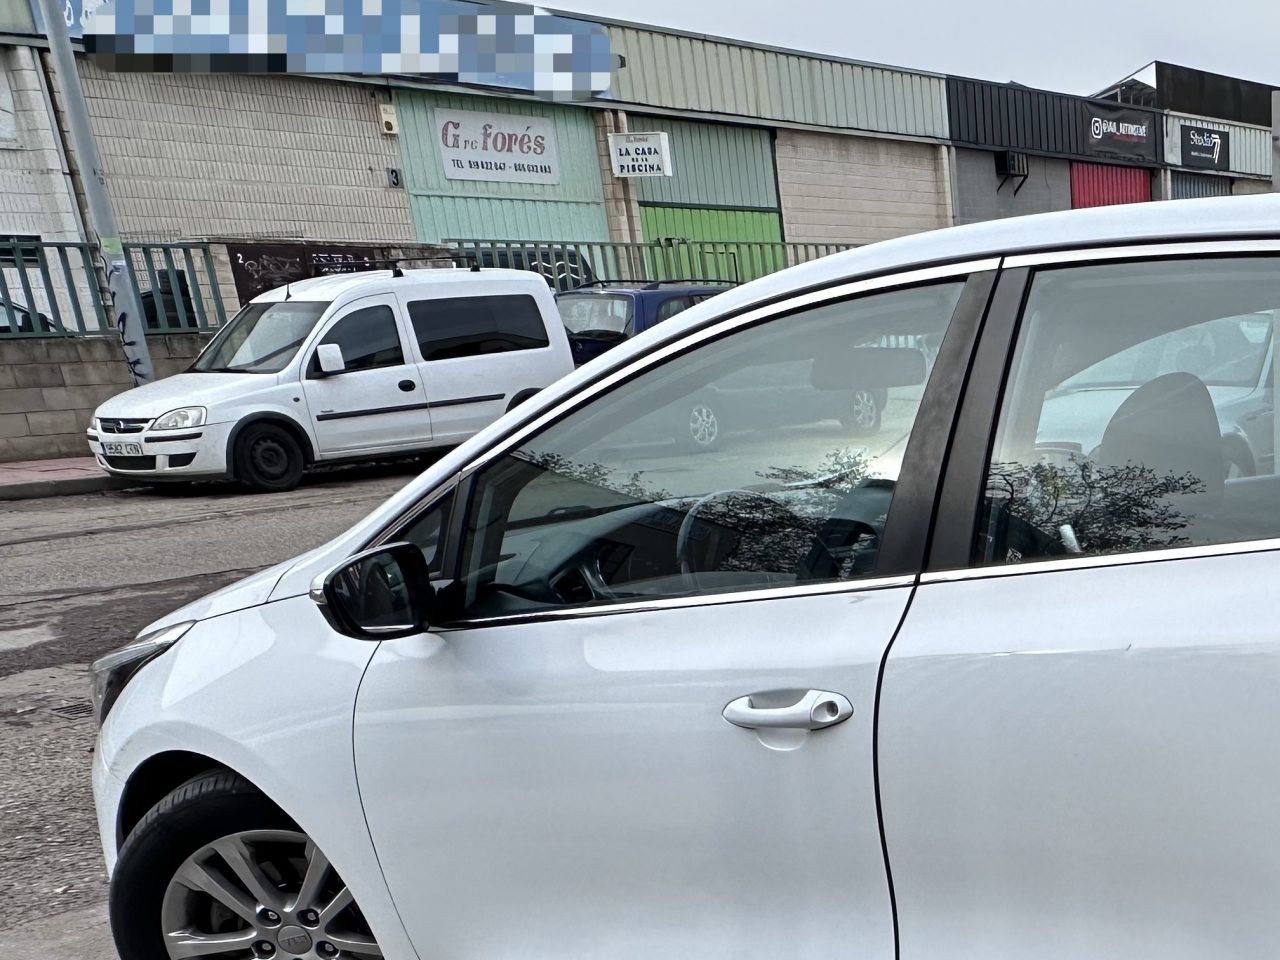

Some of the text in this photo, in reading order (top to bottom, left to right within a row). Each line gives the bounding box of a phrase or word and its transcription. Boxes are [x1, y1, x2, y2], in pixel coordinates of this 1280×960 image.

[618, 147, 659, 157] LA CASA
[620, 163, 662, 173] PISCINA
[390, 168, 399, 187] 3
[236, 253, 244, 264] 2
